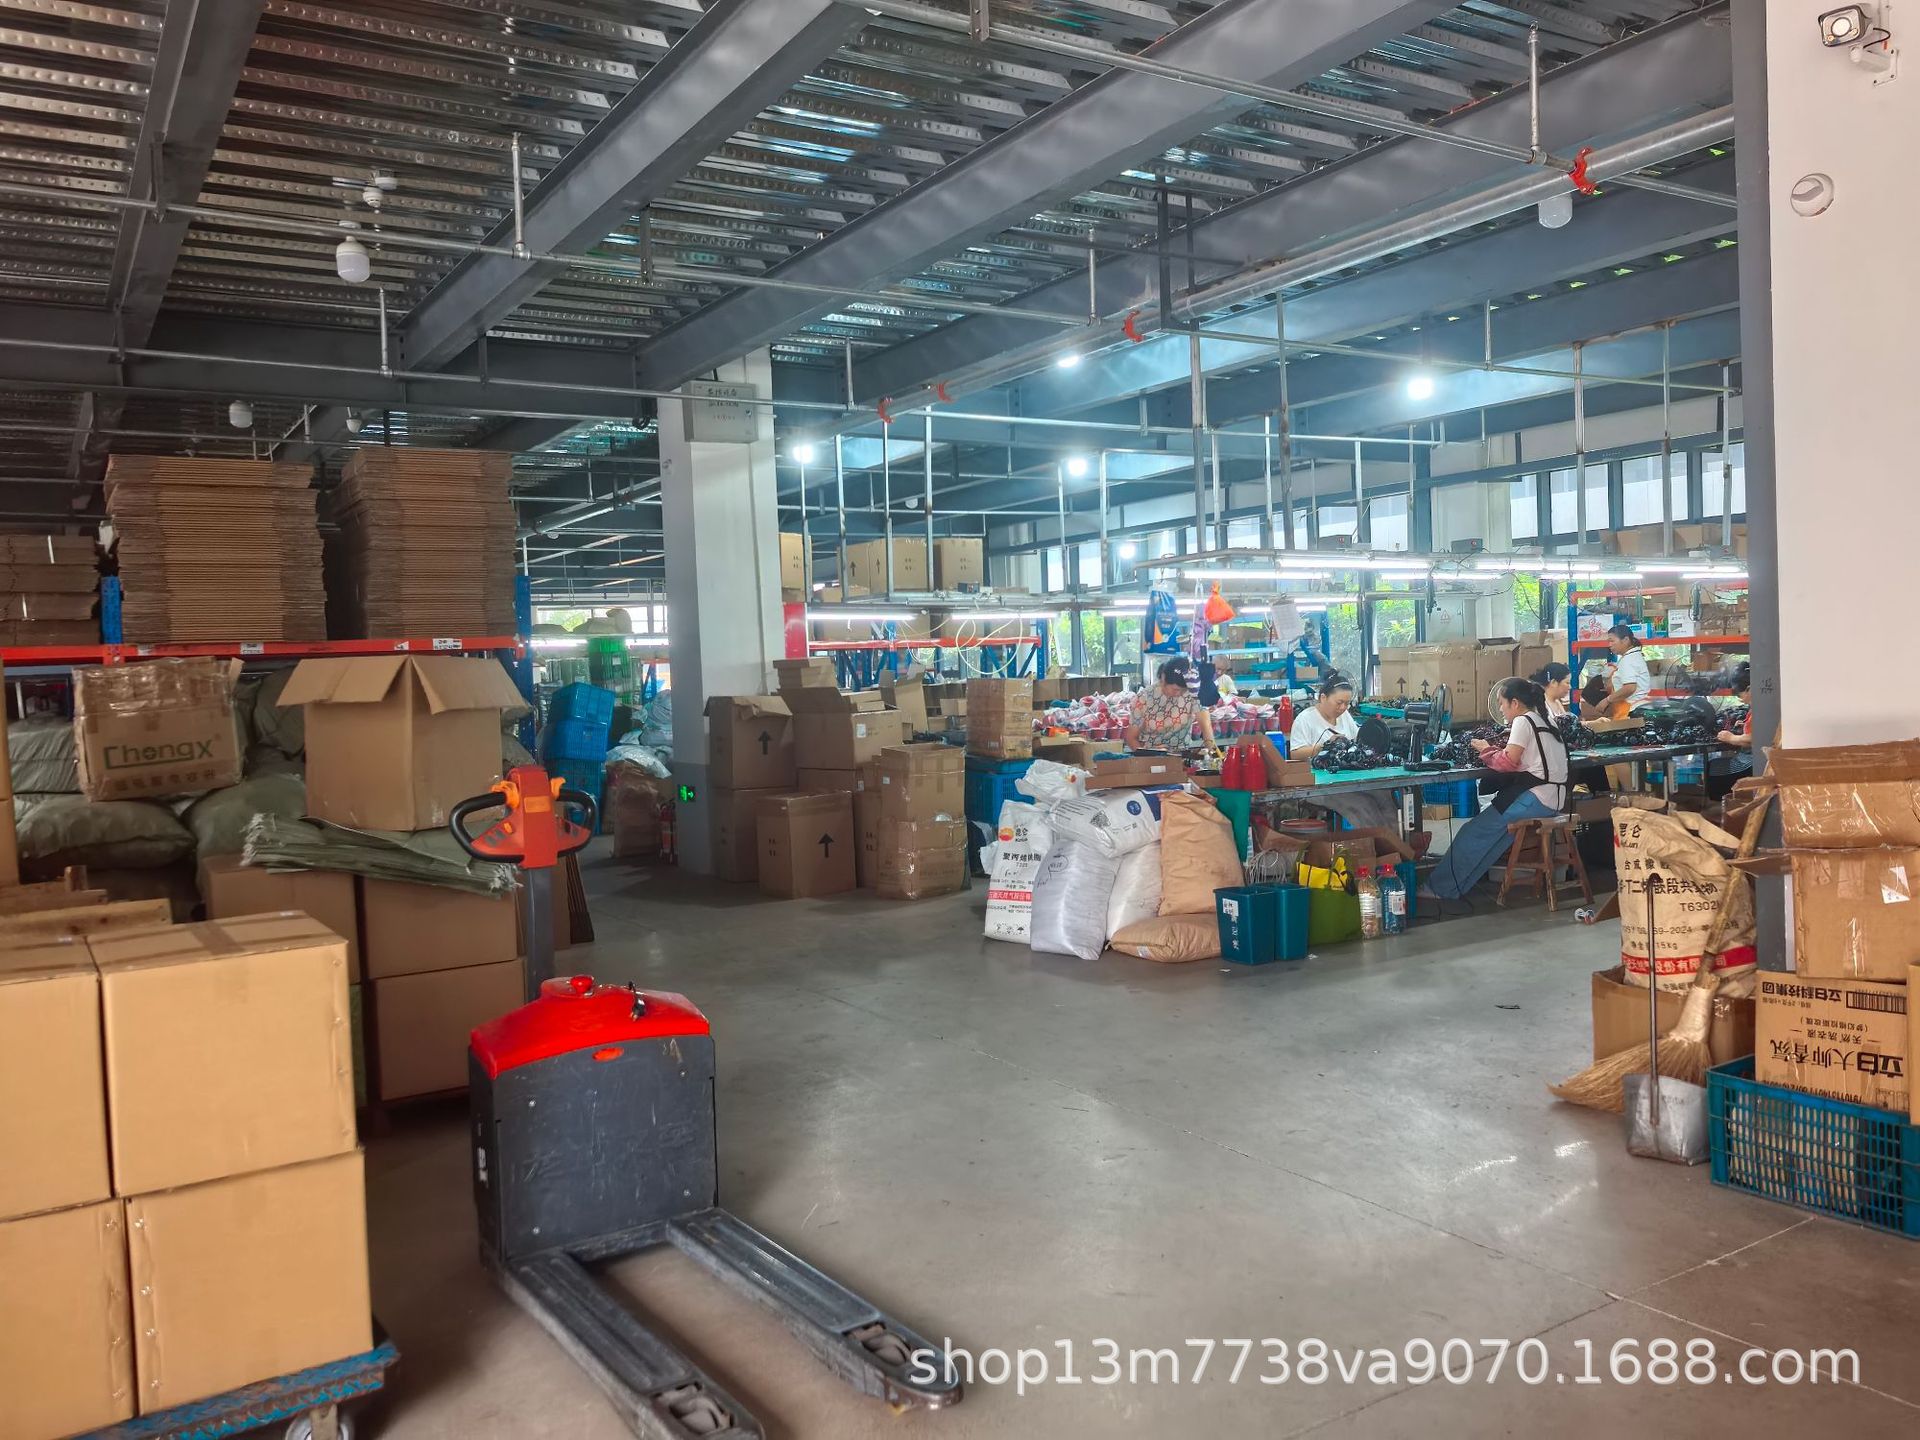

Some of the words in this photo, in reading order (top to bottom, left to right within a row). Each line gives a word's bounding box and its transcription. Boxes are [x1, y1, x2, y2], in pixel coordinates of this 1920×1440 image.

[1680, 901, 1719, 912] T6302
[1762, 981, 1842, 1002] 立白科技集团
